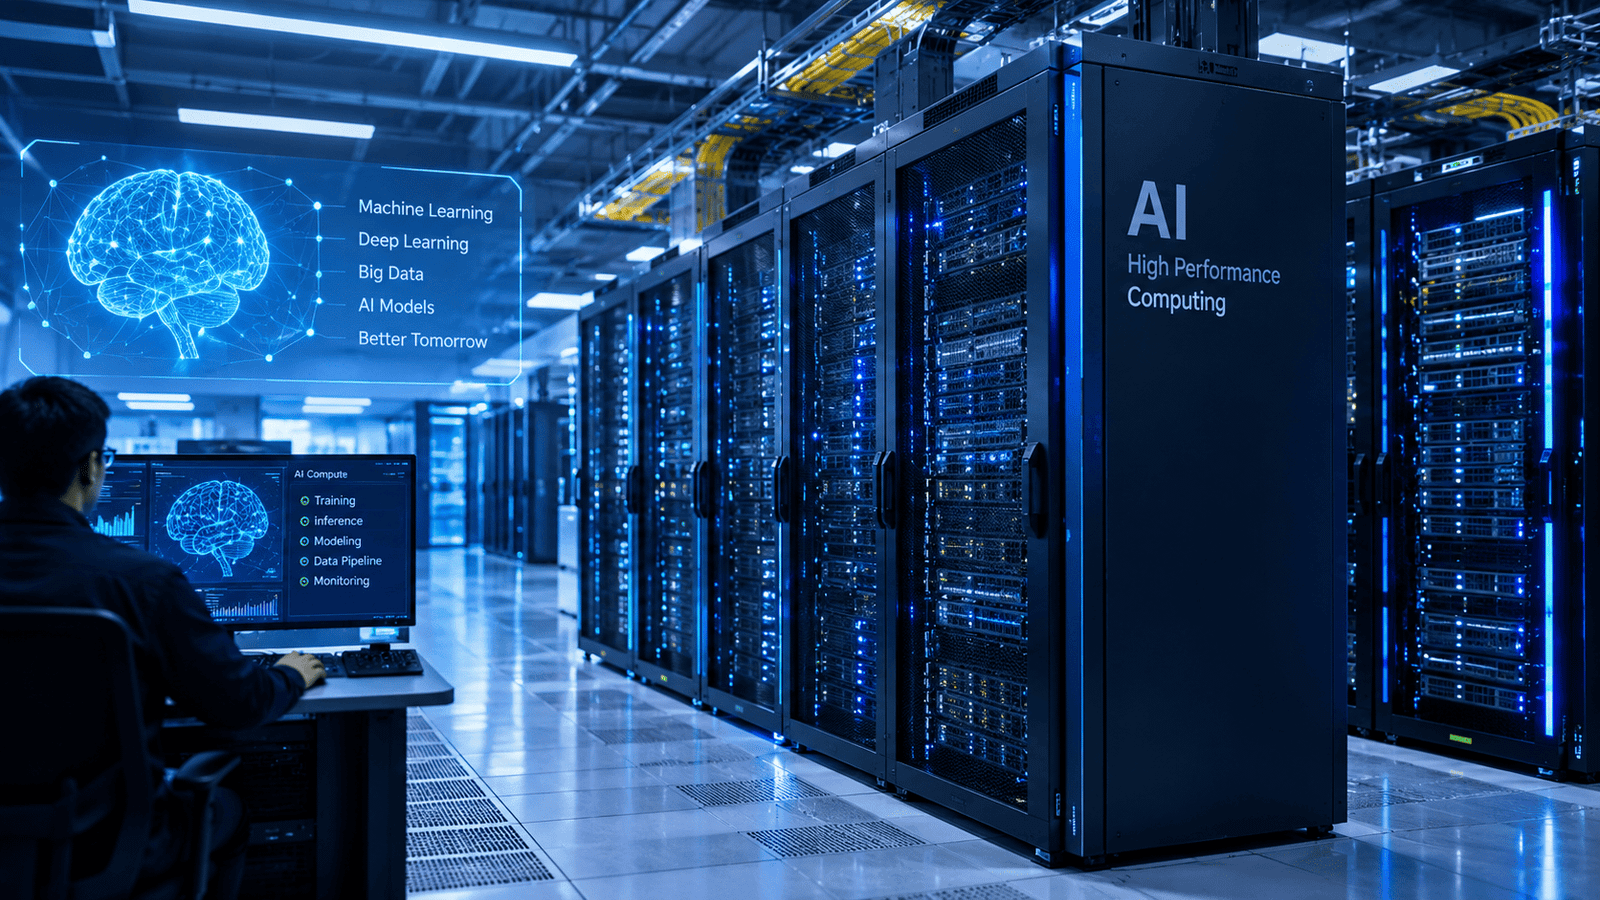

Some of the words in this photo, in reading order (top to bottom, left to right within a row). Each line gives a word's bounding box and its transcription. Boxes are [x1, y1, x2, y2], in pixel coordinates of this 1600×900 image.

[359, 198, 424, 217] Machine
[428, 202, 493, 225] Learning
[1128, 180, 1186, 240] AI
[358, 231, 399, 251] Deep
[403, 233, 469, 255] Learning
[358, 264, 383, 284] Big
[388, 265, 424, 282] Data
[1129, 253, 1168, 280] High
[1175, 257, 1280, 284] Performance
[358, 297, 374, 313] AI
[379, 297, 435, 315] Models
[1128, 286, 1225, 316] Computing
[358, 330, 408, 347] Better
[410, 332, 488, 349] Tomorrow
[306, 469, 348, 480] Compute
[314, 494, 356, 508] Training
[314, 514, 363, 526] inference
[314, 535, 362, 549] Modeling
[314, 555, 339, 566] Data
[341, 555, 383, 568] Pipeline
[313, 575, 370, 589] Monitoring
